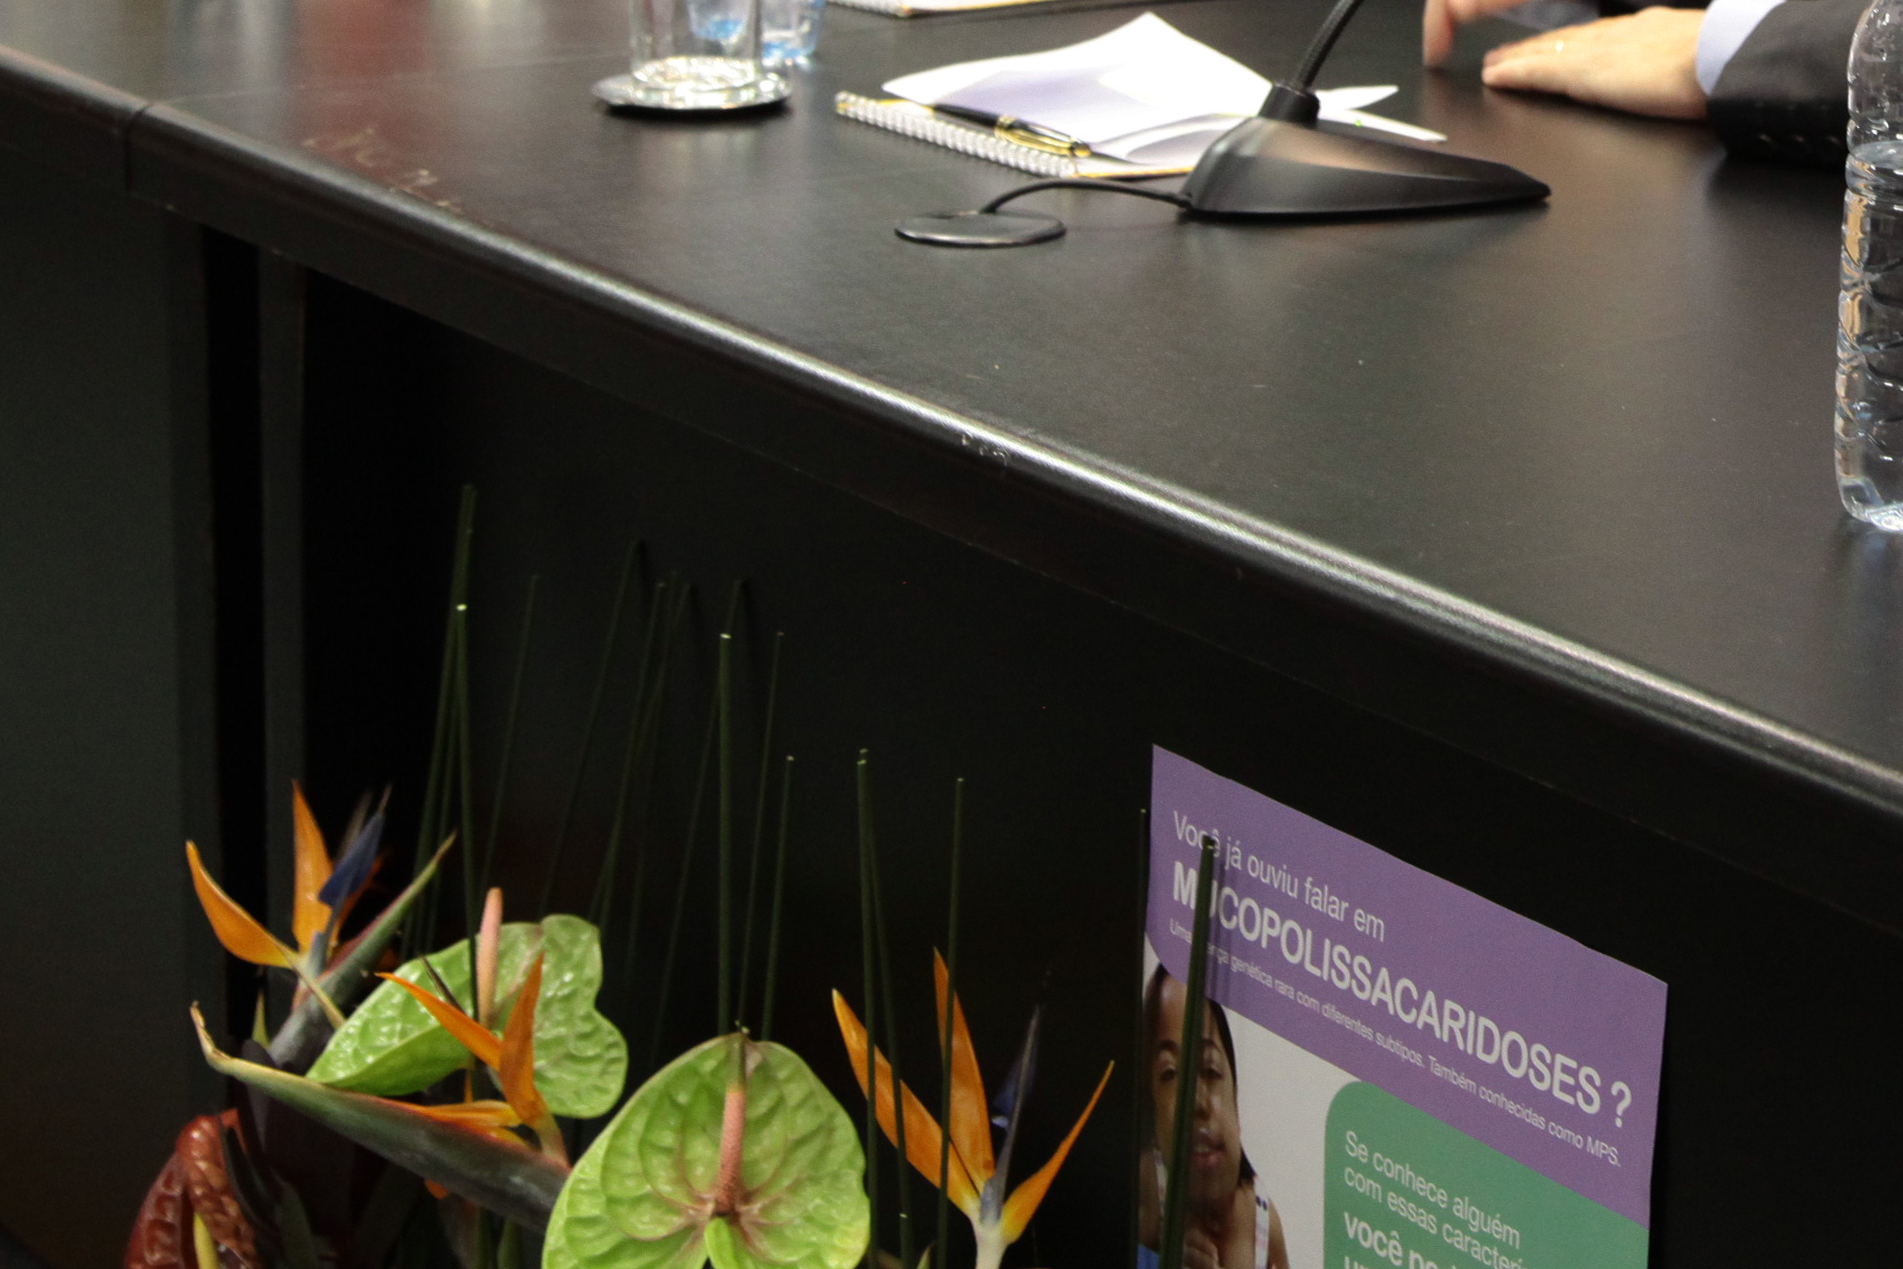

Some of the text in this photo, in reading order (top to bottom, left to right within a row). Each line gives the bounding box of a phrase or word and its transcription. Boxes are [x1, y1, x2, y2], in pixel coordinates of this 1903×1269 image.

[1225, 836, 1242, 870] já
[1247, 855, 1299, 899] ouviu
[1304, 877, 1349, 922] falar
[1354, 908, 1385, 943] em
[1296, 991, 1320, 1013] com
[1322, 1002, 1374, 1041] diferentes
[1375, 1033, 1425, 1068] subtipos.
[1428, 1055, 1477, 1095] Também
[1478, 1085, 1546, 1130] conhecidas
[1548, 1121, 1584, 1149] como
[1586, 1136, 1622, 1168] MPS.
[1611, 1081, 1632, 1128] ?
[1344, 1167, 1382, 1203] com
[1387, 1190, 1437, 1234] essas
[1345, 1130, 1520, 1250] Se conhece alguém
[1344, 1211, 1403, 1267] você
